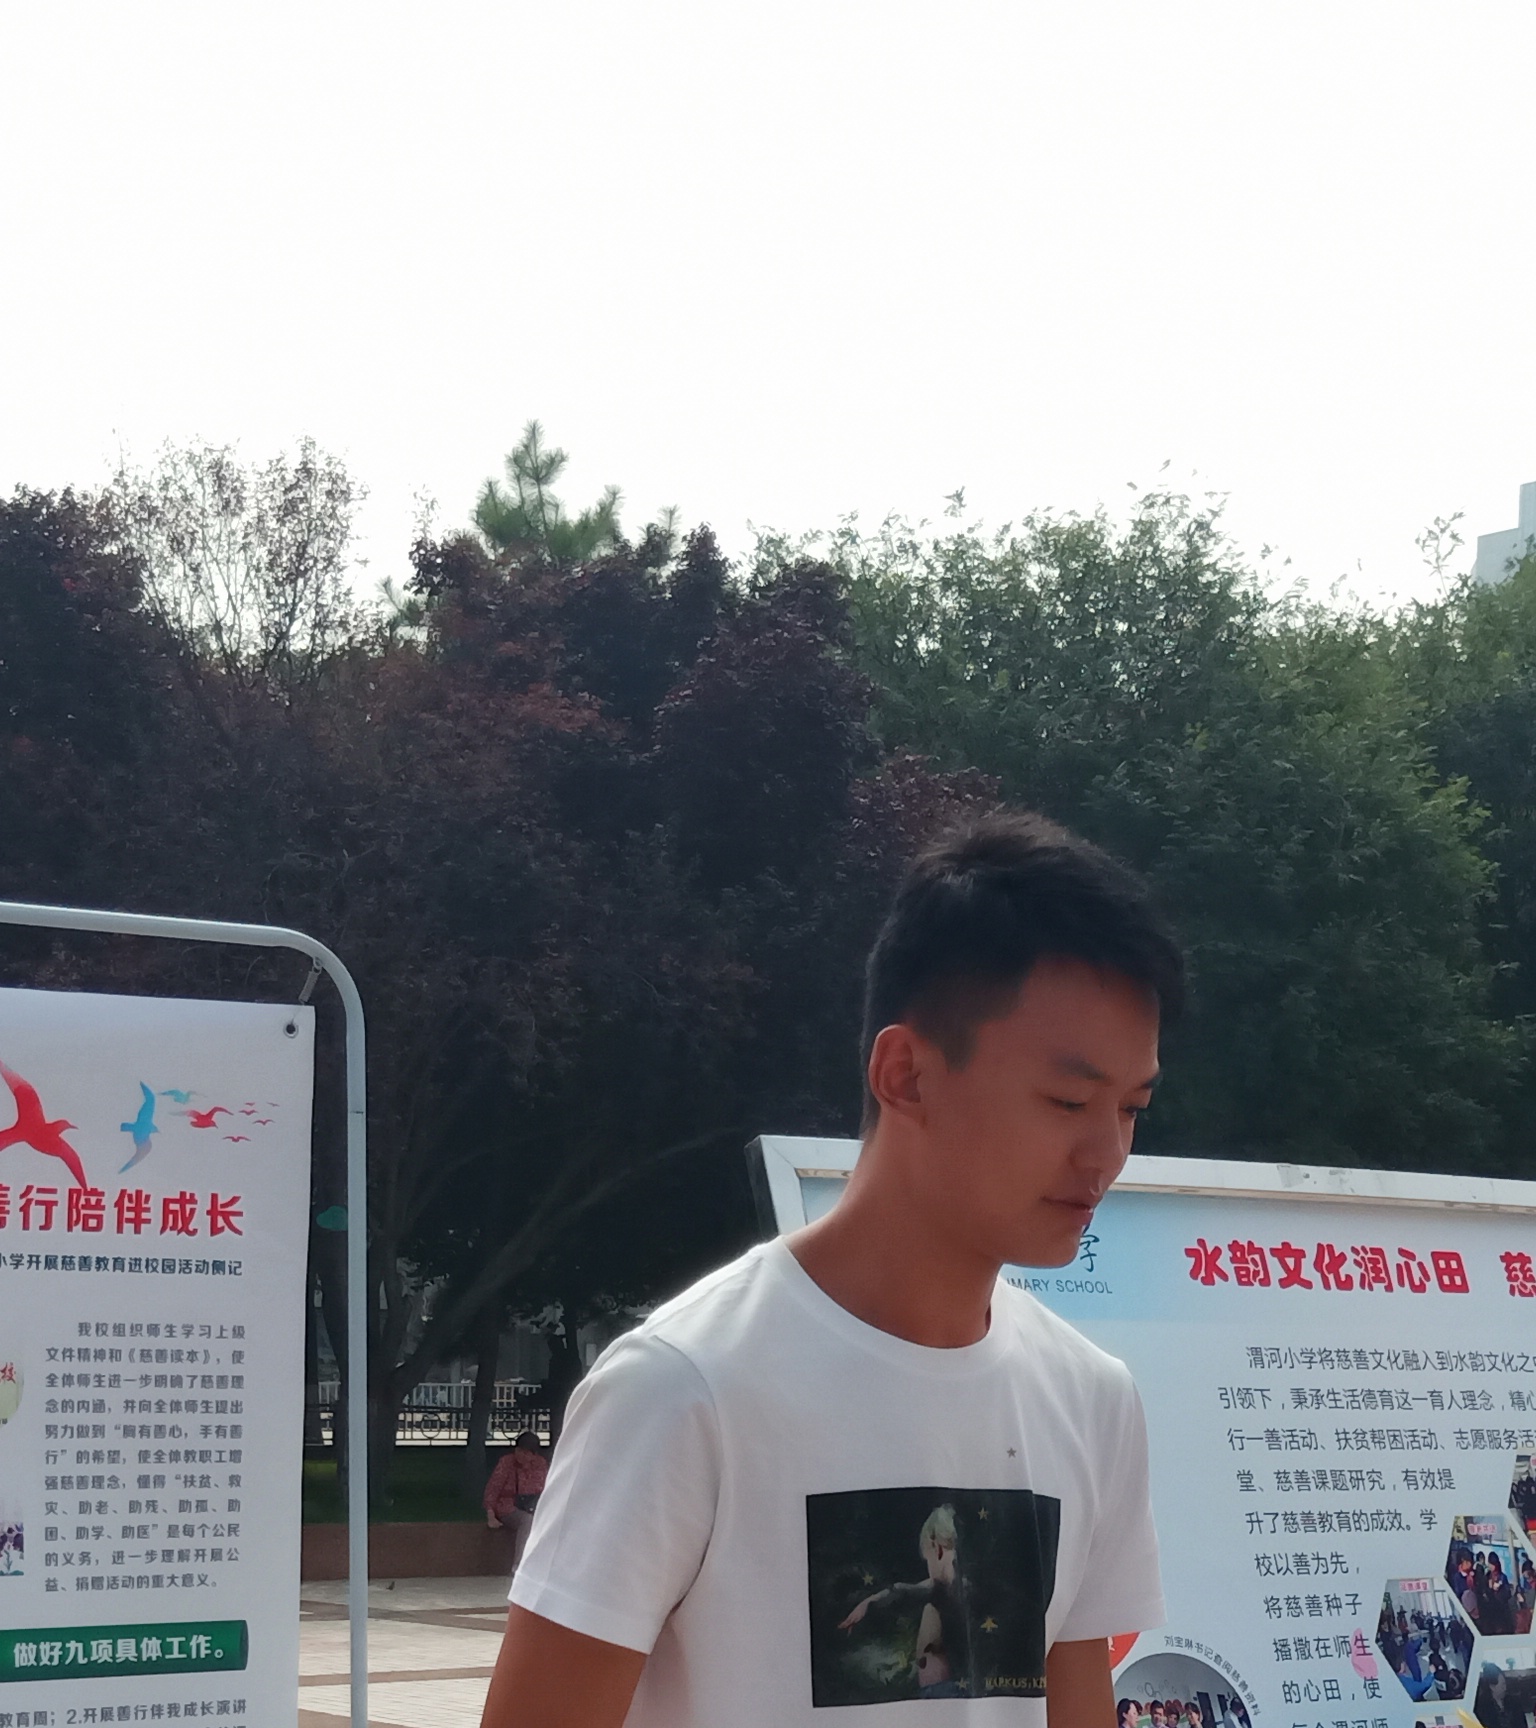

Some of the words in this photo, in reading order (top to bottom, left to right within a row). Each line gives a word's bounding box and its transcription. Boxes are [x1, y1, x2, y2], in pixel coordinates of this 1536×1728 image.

[1184, 1238, 1471, 1295] 水韵文化润心田
[78, 1322, 246, 1340] 我校组织师生学习上级
[45, 1373, 244, 1389] 全体师生进一步明确了慈善理
[1264, 1592, 1363, 1620] 将慈善种子
[1273, 1633, 1374, 1662] 播撒在师生
[1282, 1676, 1382, 1705] 的心田，使
